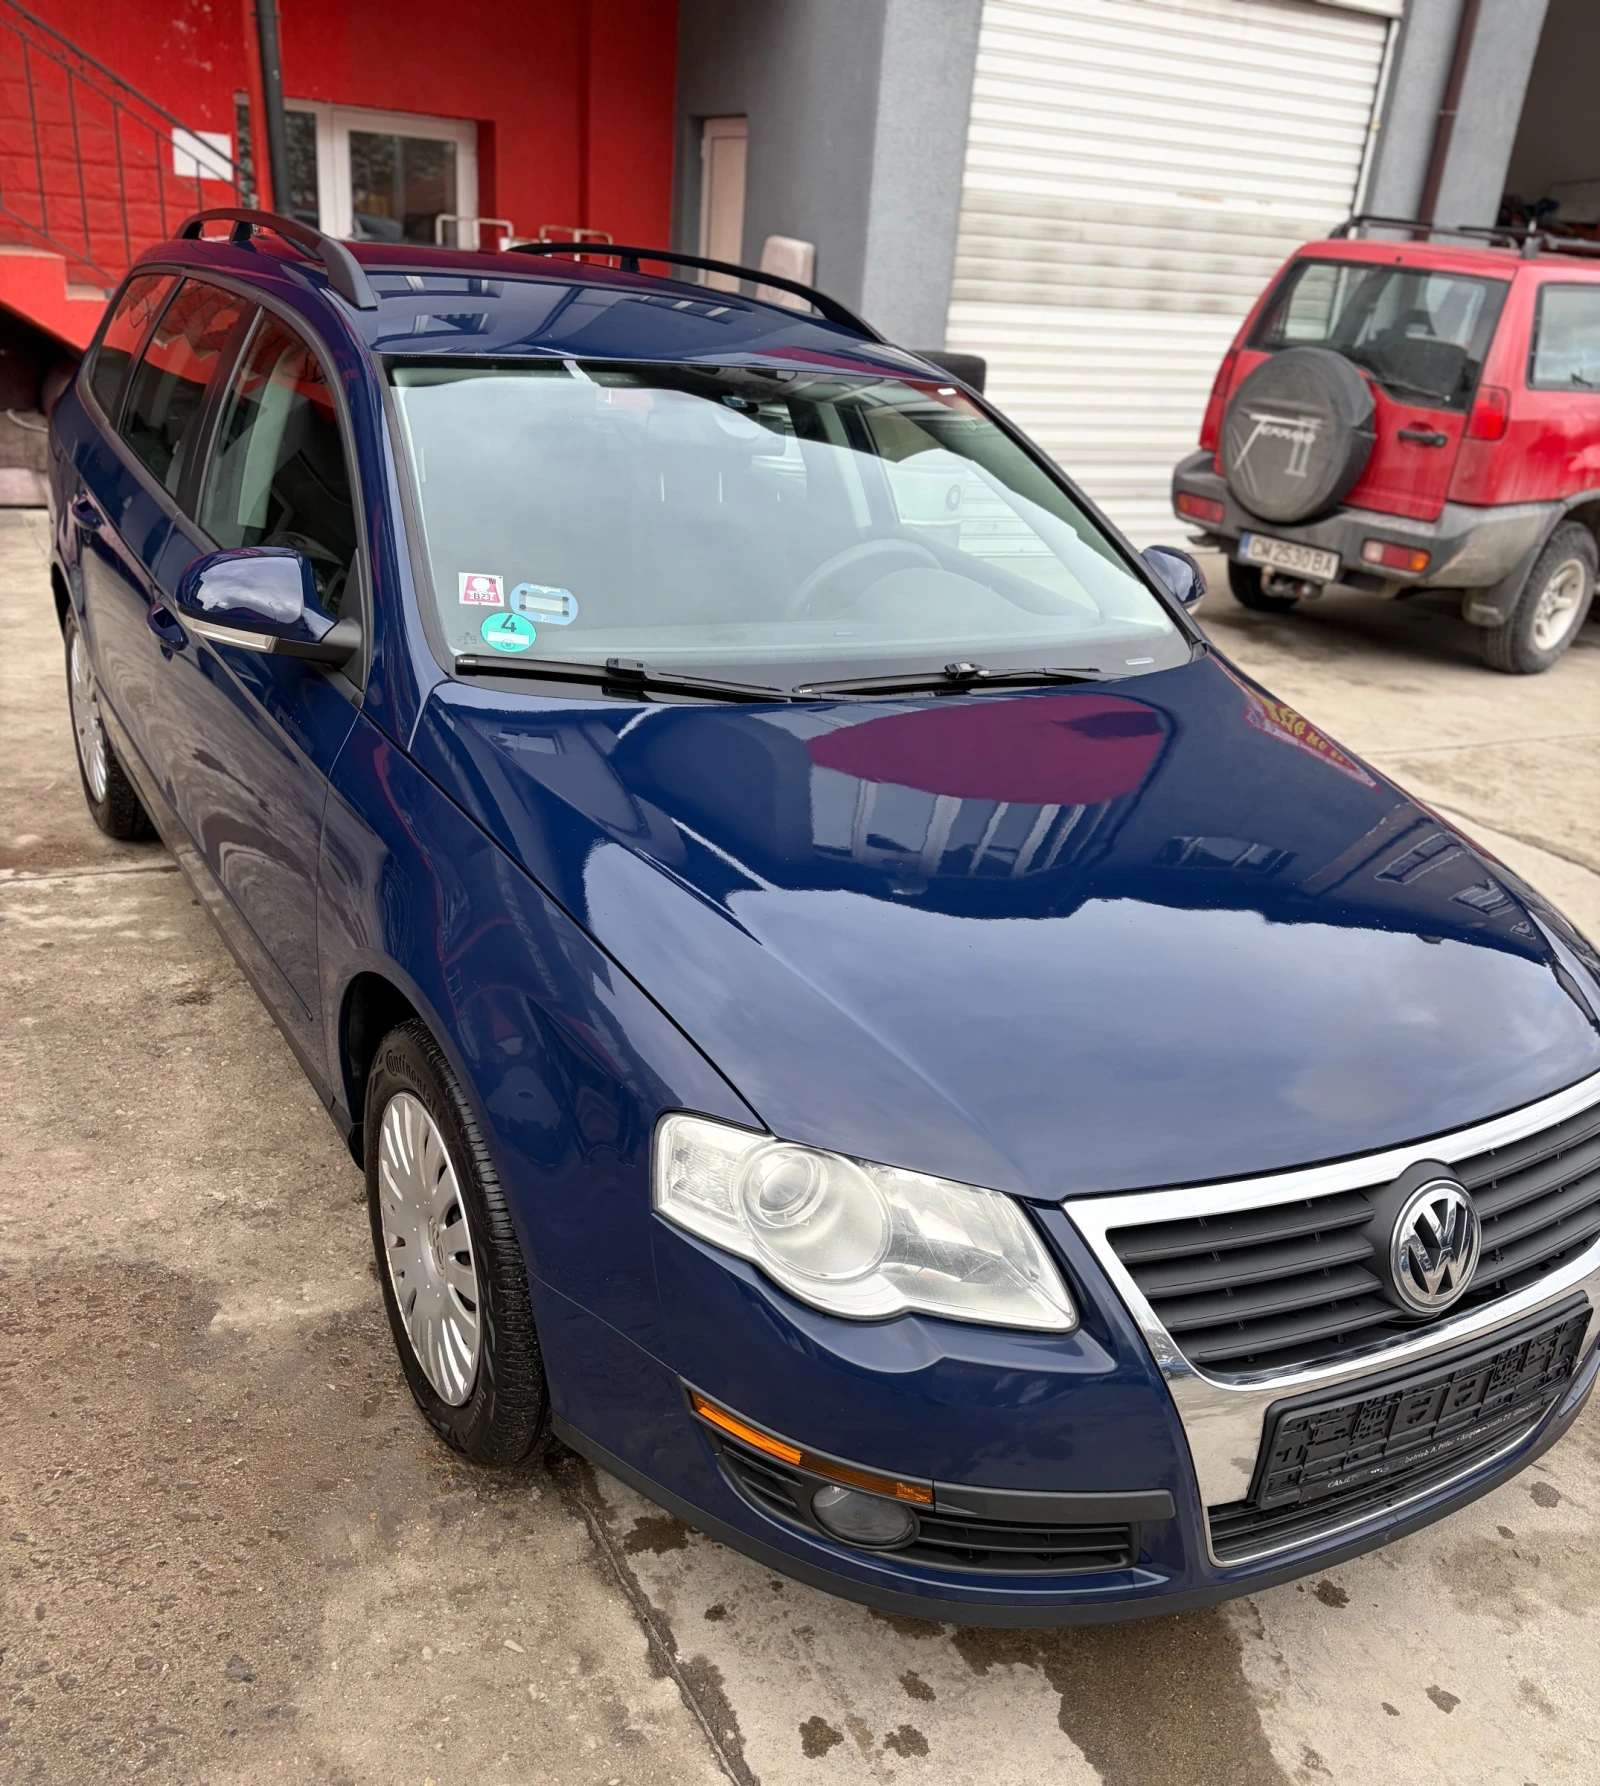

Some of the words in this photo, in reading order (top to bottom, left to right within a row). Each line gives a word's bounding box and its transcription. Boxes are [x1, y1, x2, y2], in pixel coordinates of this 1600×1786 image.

[1273, 544, 1311, 568] 2530
[1312, 551, 1335, 576] BA
[500, 614, 517, 633] 4
[386, 1049, 437, 1114] Continental
[1396, 1184, 1479, 1307] VW
